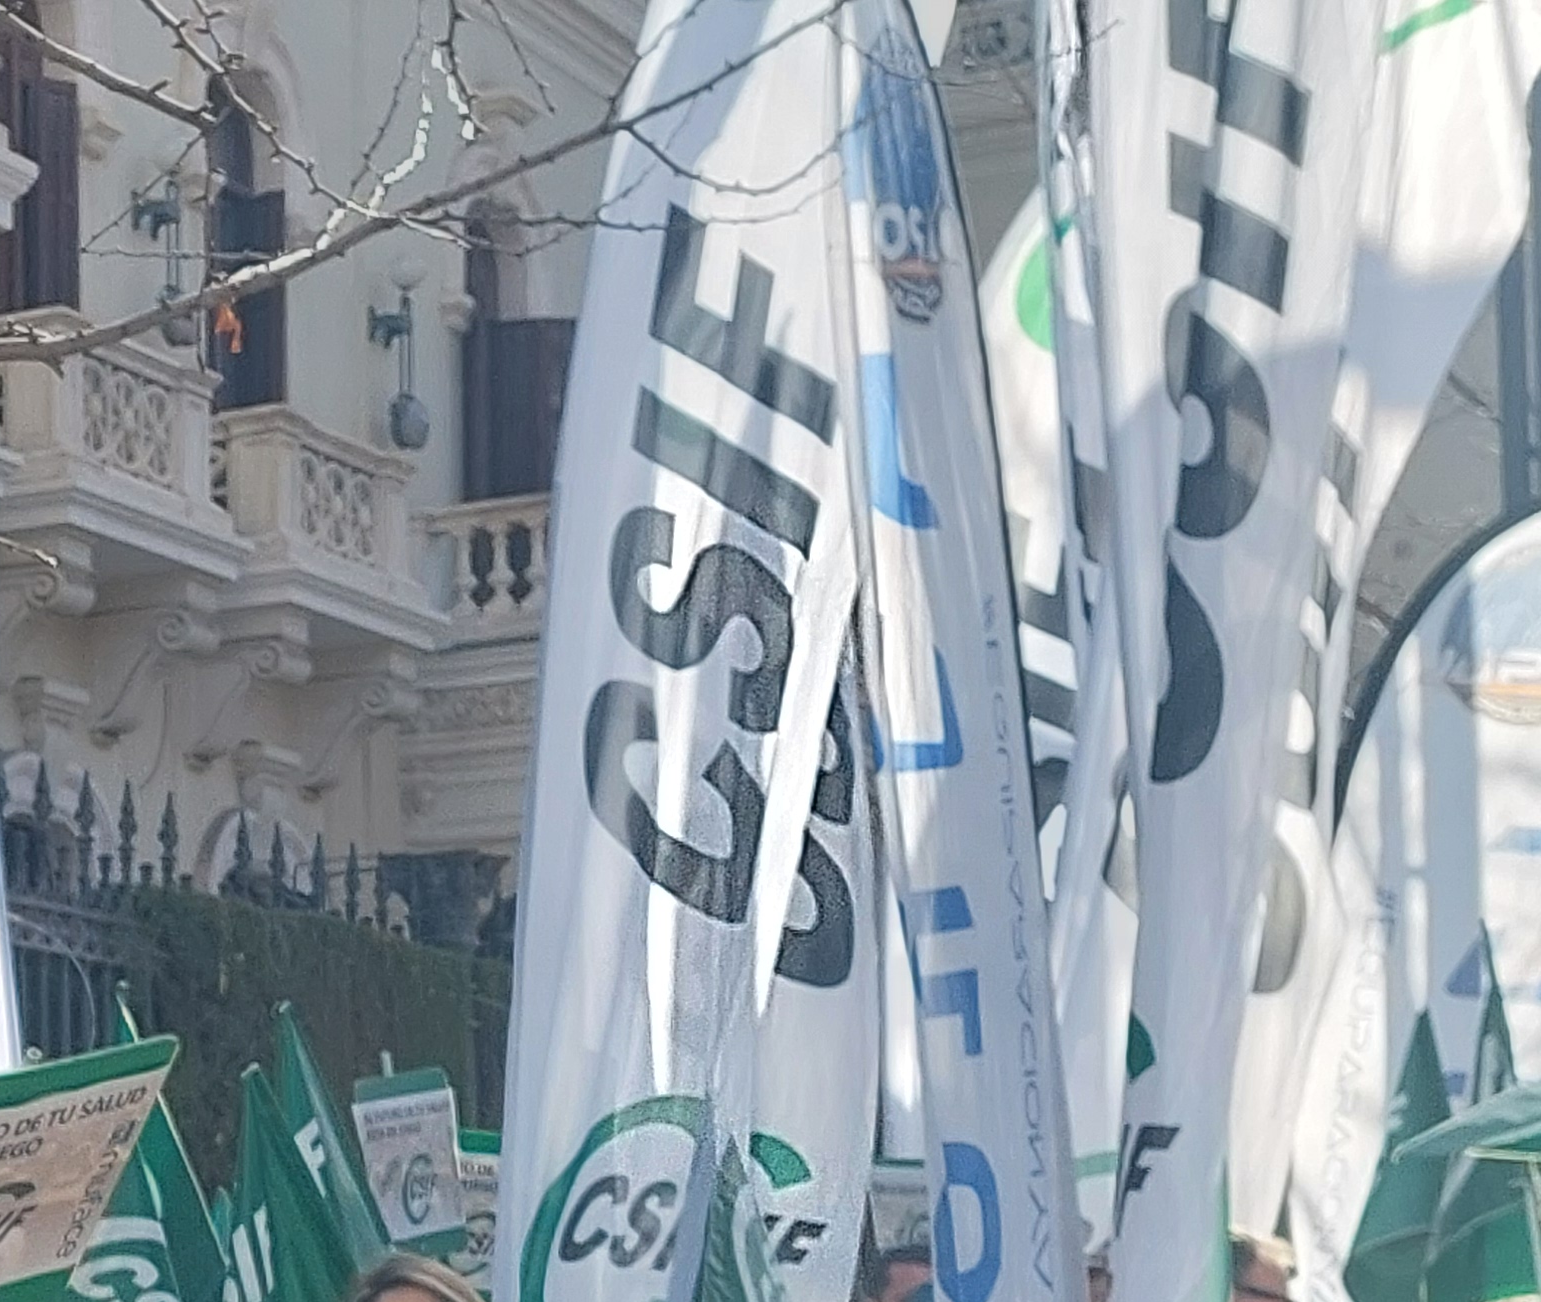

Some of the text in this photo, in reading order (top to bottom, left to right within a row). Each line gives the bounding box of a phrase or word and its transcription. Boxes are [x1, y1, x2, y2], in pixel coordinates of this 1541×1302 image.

[584, 205, 838, 925] CSIF
[14, 1116, 42, 1135] DE
[47, 1106, 77, 1127] TU
[77, 1086, 148, 1119] SALUD
